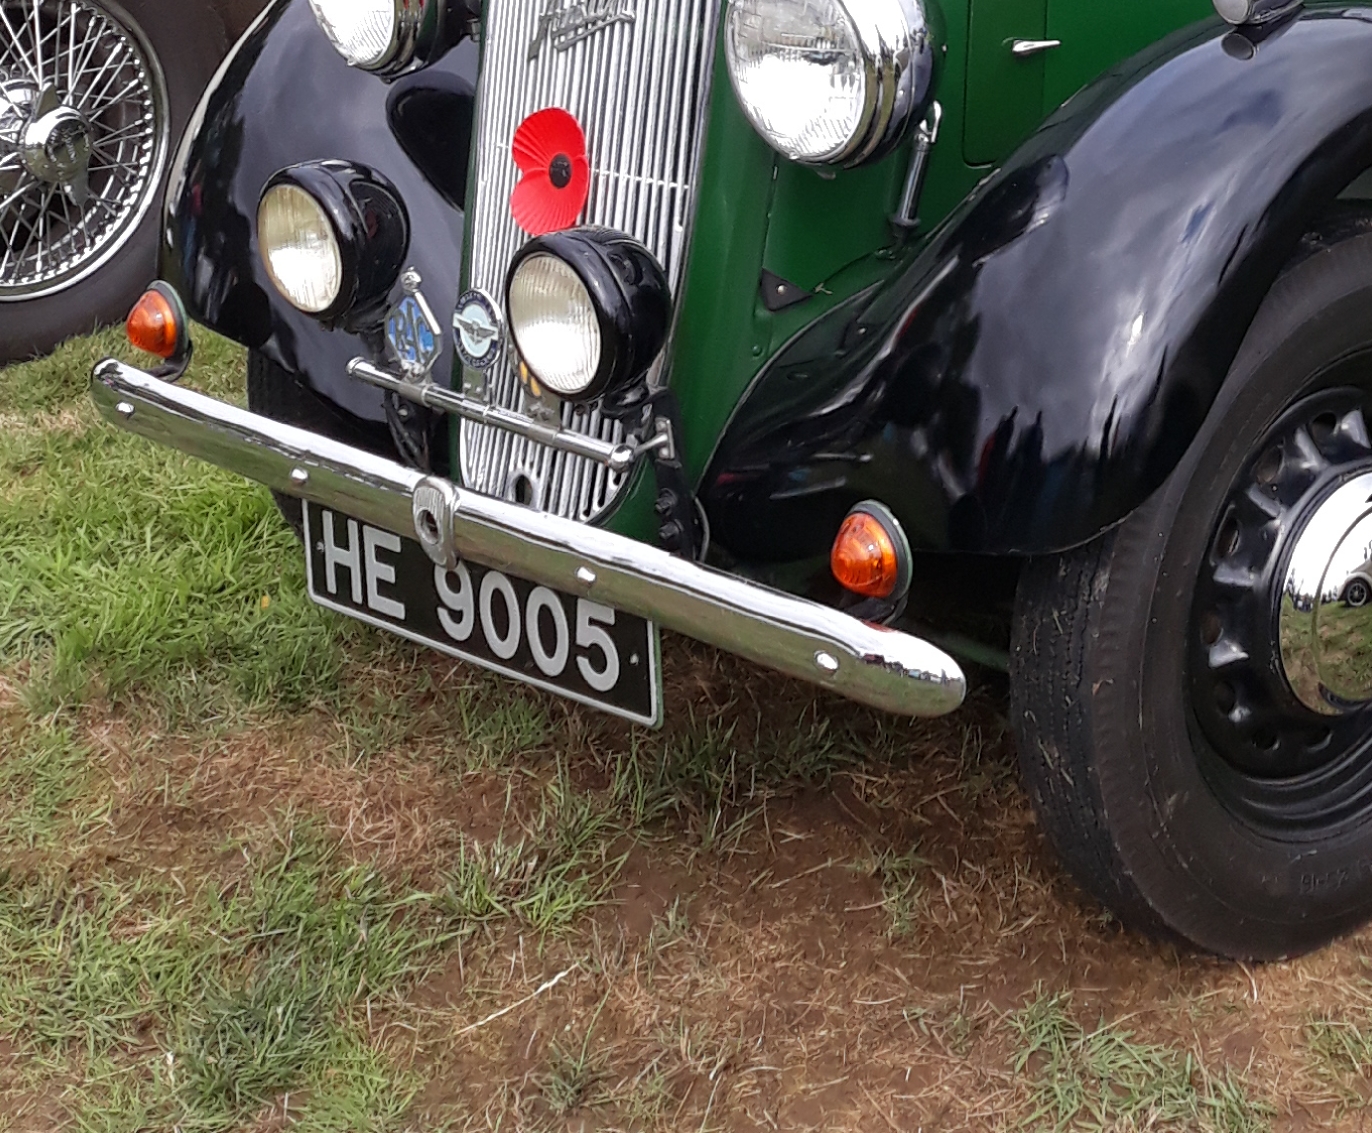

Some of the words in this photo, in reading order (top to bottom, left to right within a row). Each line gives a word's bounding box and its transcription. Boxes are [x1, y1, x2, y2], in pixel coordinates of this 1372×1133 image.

[388, 297, 435, 366] RAC
[321, 509, 406, 620] HE
[433, 558, 620, 693] 9005
